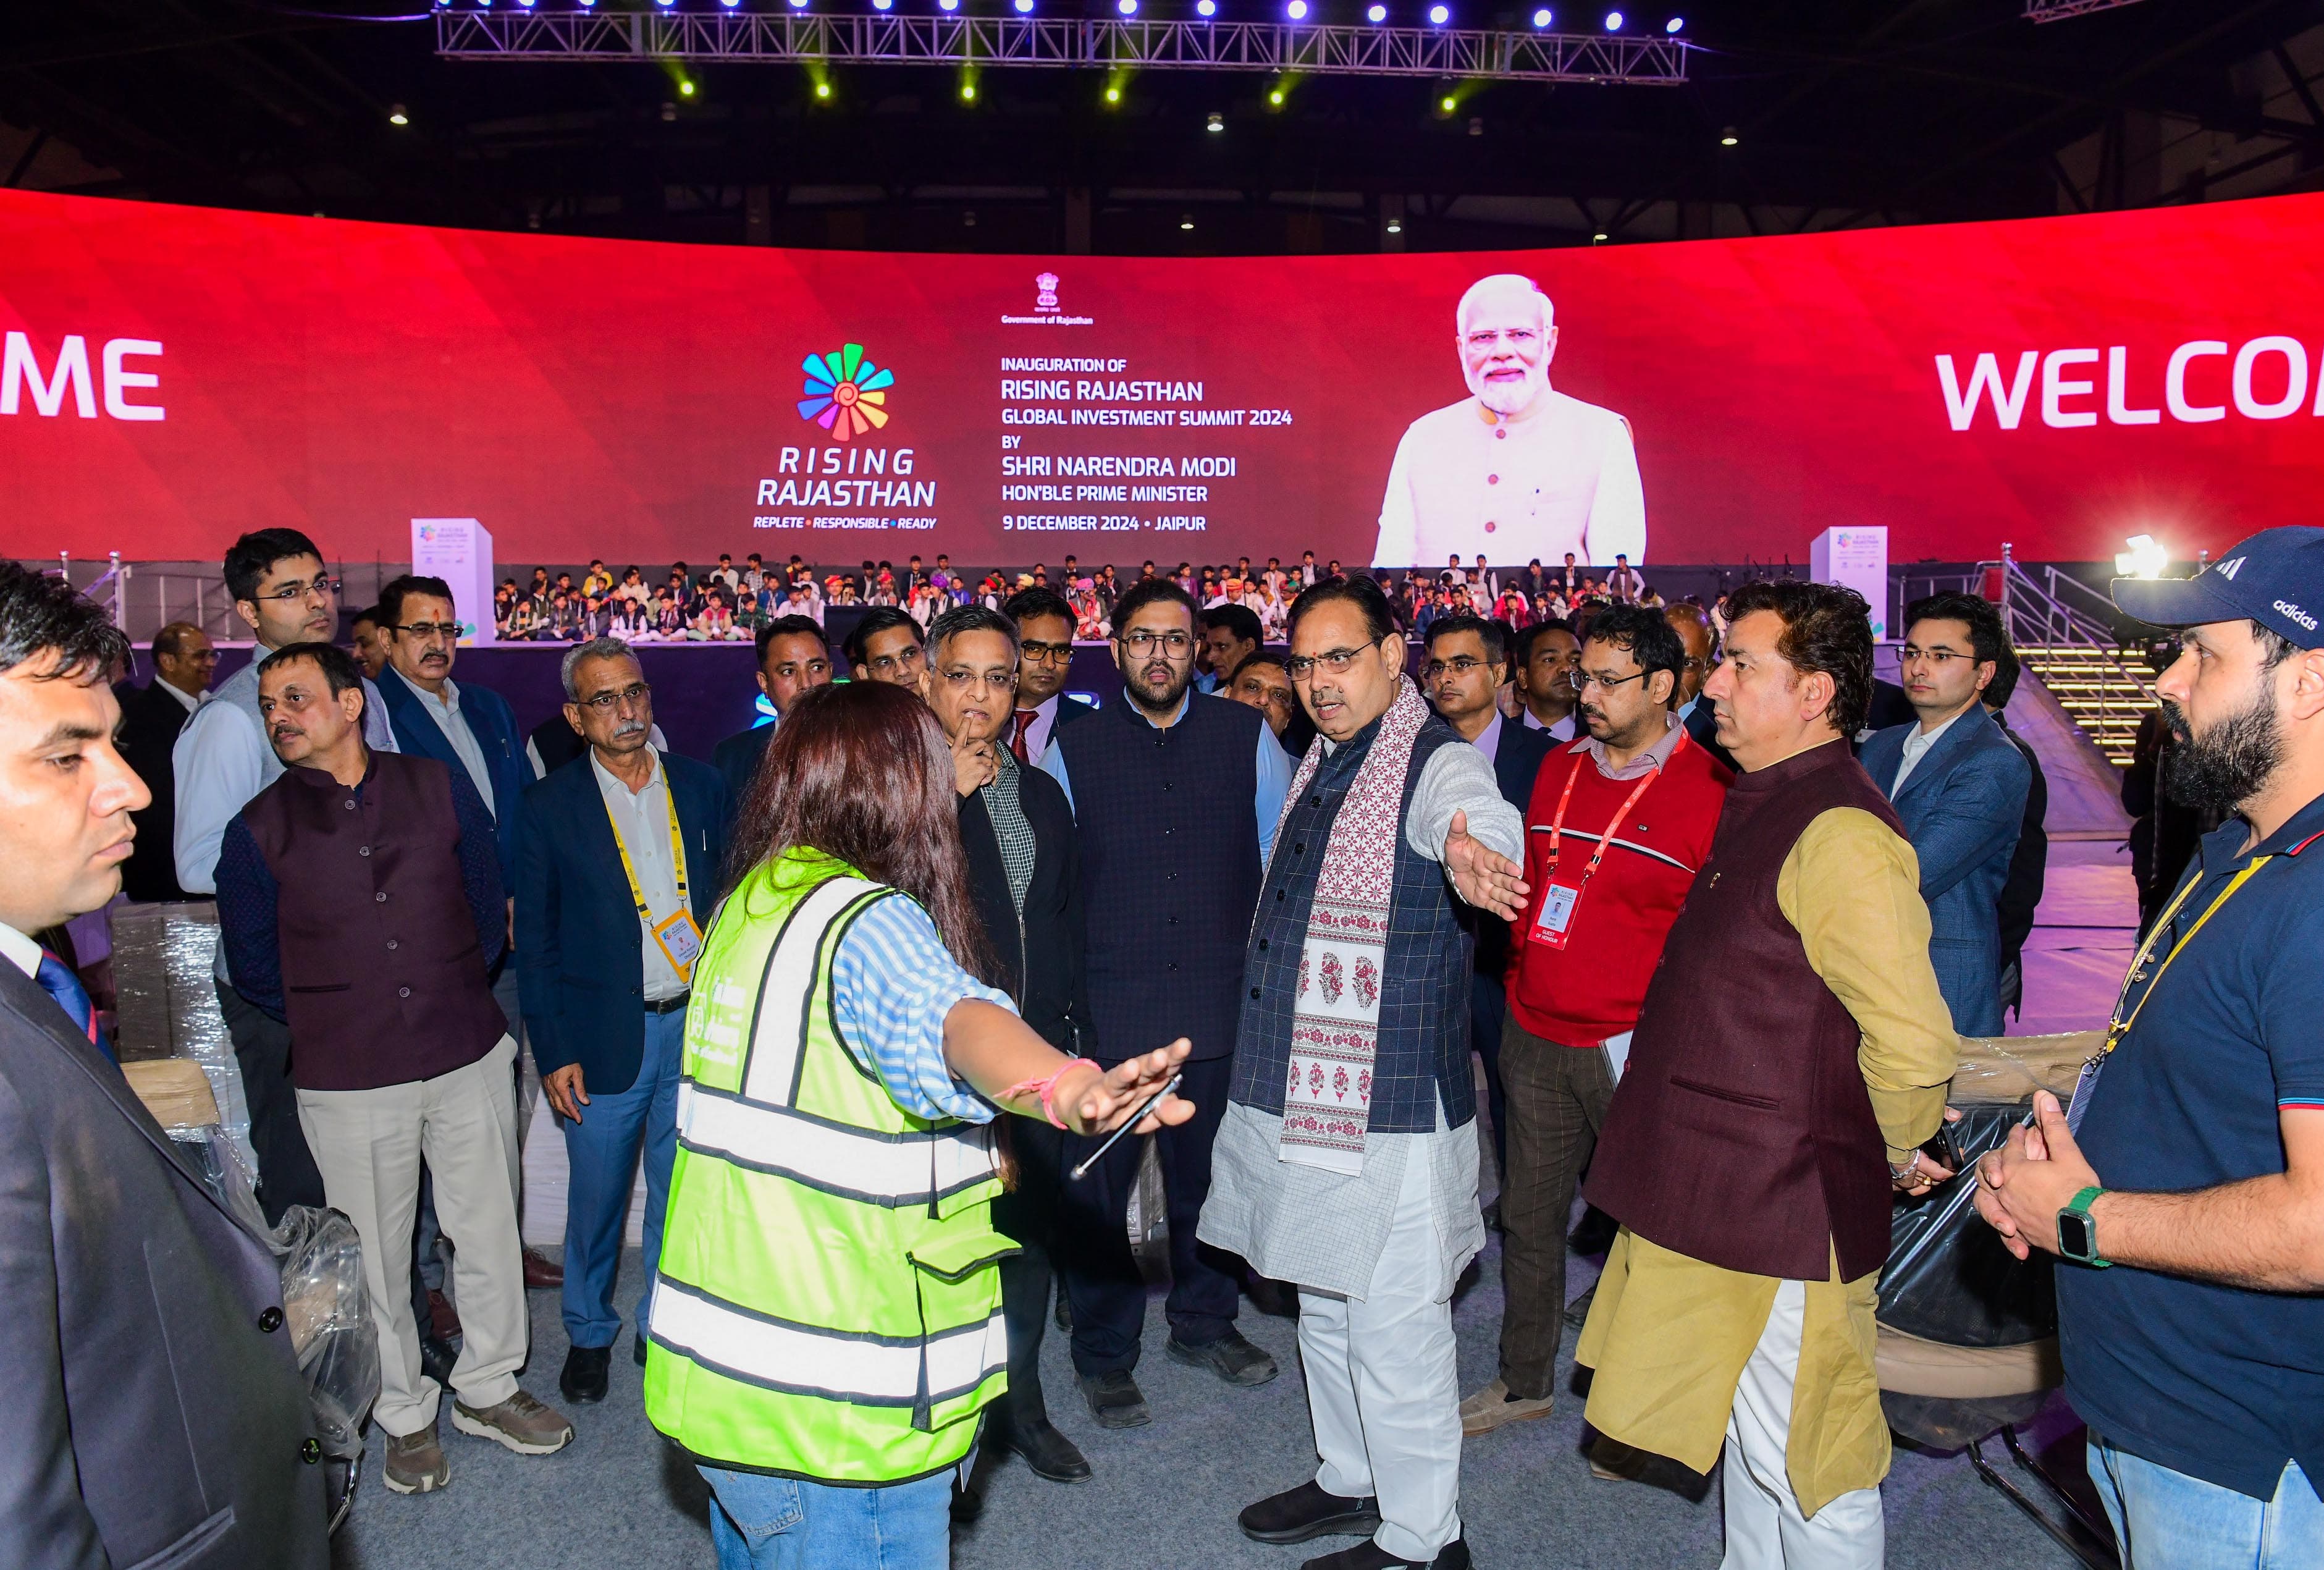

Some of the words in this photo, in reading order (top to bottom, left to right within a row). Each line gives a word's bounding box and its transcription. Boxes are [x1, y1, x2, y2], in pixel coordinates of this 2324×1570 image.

[1001, 315, 1046, 324] Government
[1047, 316, 1055, 324] of
[1056, 316, 1093, 326] Rajasthan
[1001, 358, 1105, 372] INAUGURATION
[1108, 359, 1127, 373] OF
[0, 331, 165, 421] ME
[1935, 336, 2324, 431] WELCO
[1001, 379, 1071, 400] RISING
[1077, 380, 1203, 402] RAJASTHAN
[1001, 408, 1068, 425] GLOBAL
[1071, 409, 1176, 426] INVESTMENT
[1179, 410, 1246, 426] SUMMIT
[1249, 410, 1293, 426] 2024
[1001, 435, 1021, 449] BY
[778, 447, 914, 475] RISING
[1002, 456, 1051, 476] SHRI
[1057, 456, 1175, 477] NARENDRA
[1181, 457, 1236, 477] MODI
[757, 479, 936, 507] RAJASTHAN
[1002, 484, 1073, 501] HON'BLE
[1077, 485, 1127, 502] PRIME
[1131, 486, 1208, 502] MINISTER
[754, 517, 804, 528] REPLETE
[813, 517, 889, 530] RESPONSIBLE
[898, 518, 937, 530] READY
[1003, 515, 1013, 530] 9
[1016, 515, 1097, 530] DECEMBER
[1100, 515, 1140, 531] 2024
[1154, 516, 1206, 531] JAIPUR
[2273, 599, 2318, 631] adidas
[1541, 935, 1558, 943] HONOUR
